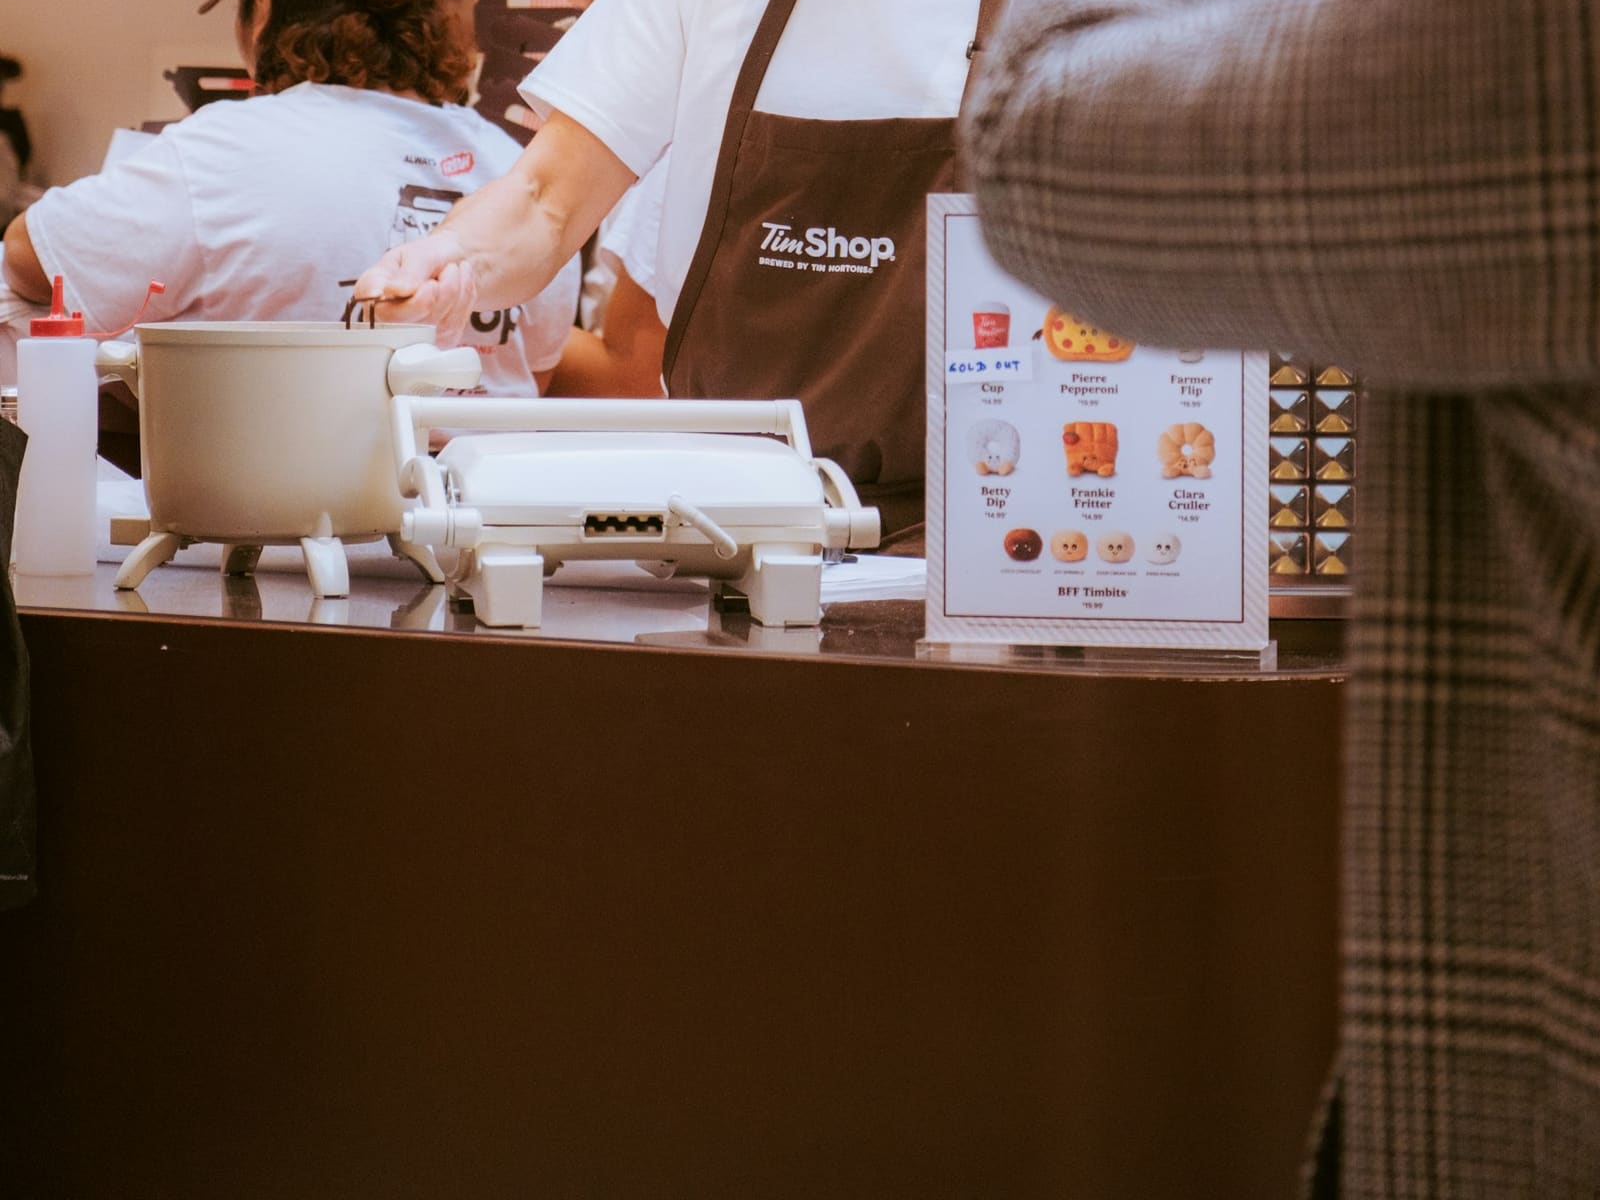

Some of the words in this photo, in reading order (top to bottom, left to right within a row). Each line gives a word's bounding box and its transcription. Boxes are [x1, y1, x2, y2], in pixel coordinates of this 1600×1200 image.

[758, 256, 795, 269] BREWED
[797, 261, 809, 271] BY
[948, 360, 987, 373] SOLD
[995, 360, 1021, 372] OUT
[1071, 373, 1108, 384] Pierre
[1170, 374, 1214, 385] Farmer
[981, 383, 1005, 395] Cup
[1060, 384, 1119, 397] Pepperoni
[1180, 385, 1203, 397] Flip
[981, 486, 1012, 498] Betty
[1070, 487, 1116, 498] Frankie
[1173, 489, 1206, 500] Clara
[986, 498, 1007, 509] Dip
[1073, 498, 1113, 510] Fritter
[1168, 500, 1211, 511] Cruller
[1058, 586, 1081, 597] BFF
[1083, 586, 1128, 598] Timbits
